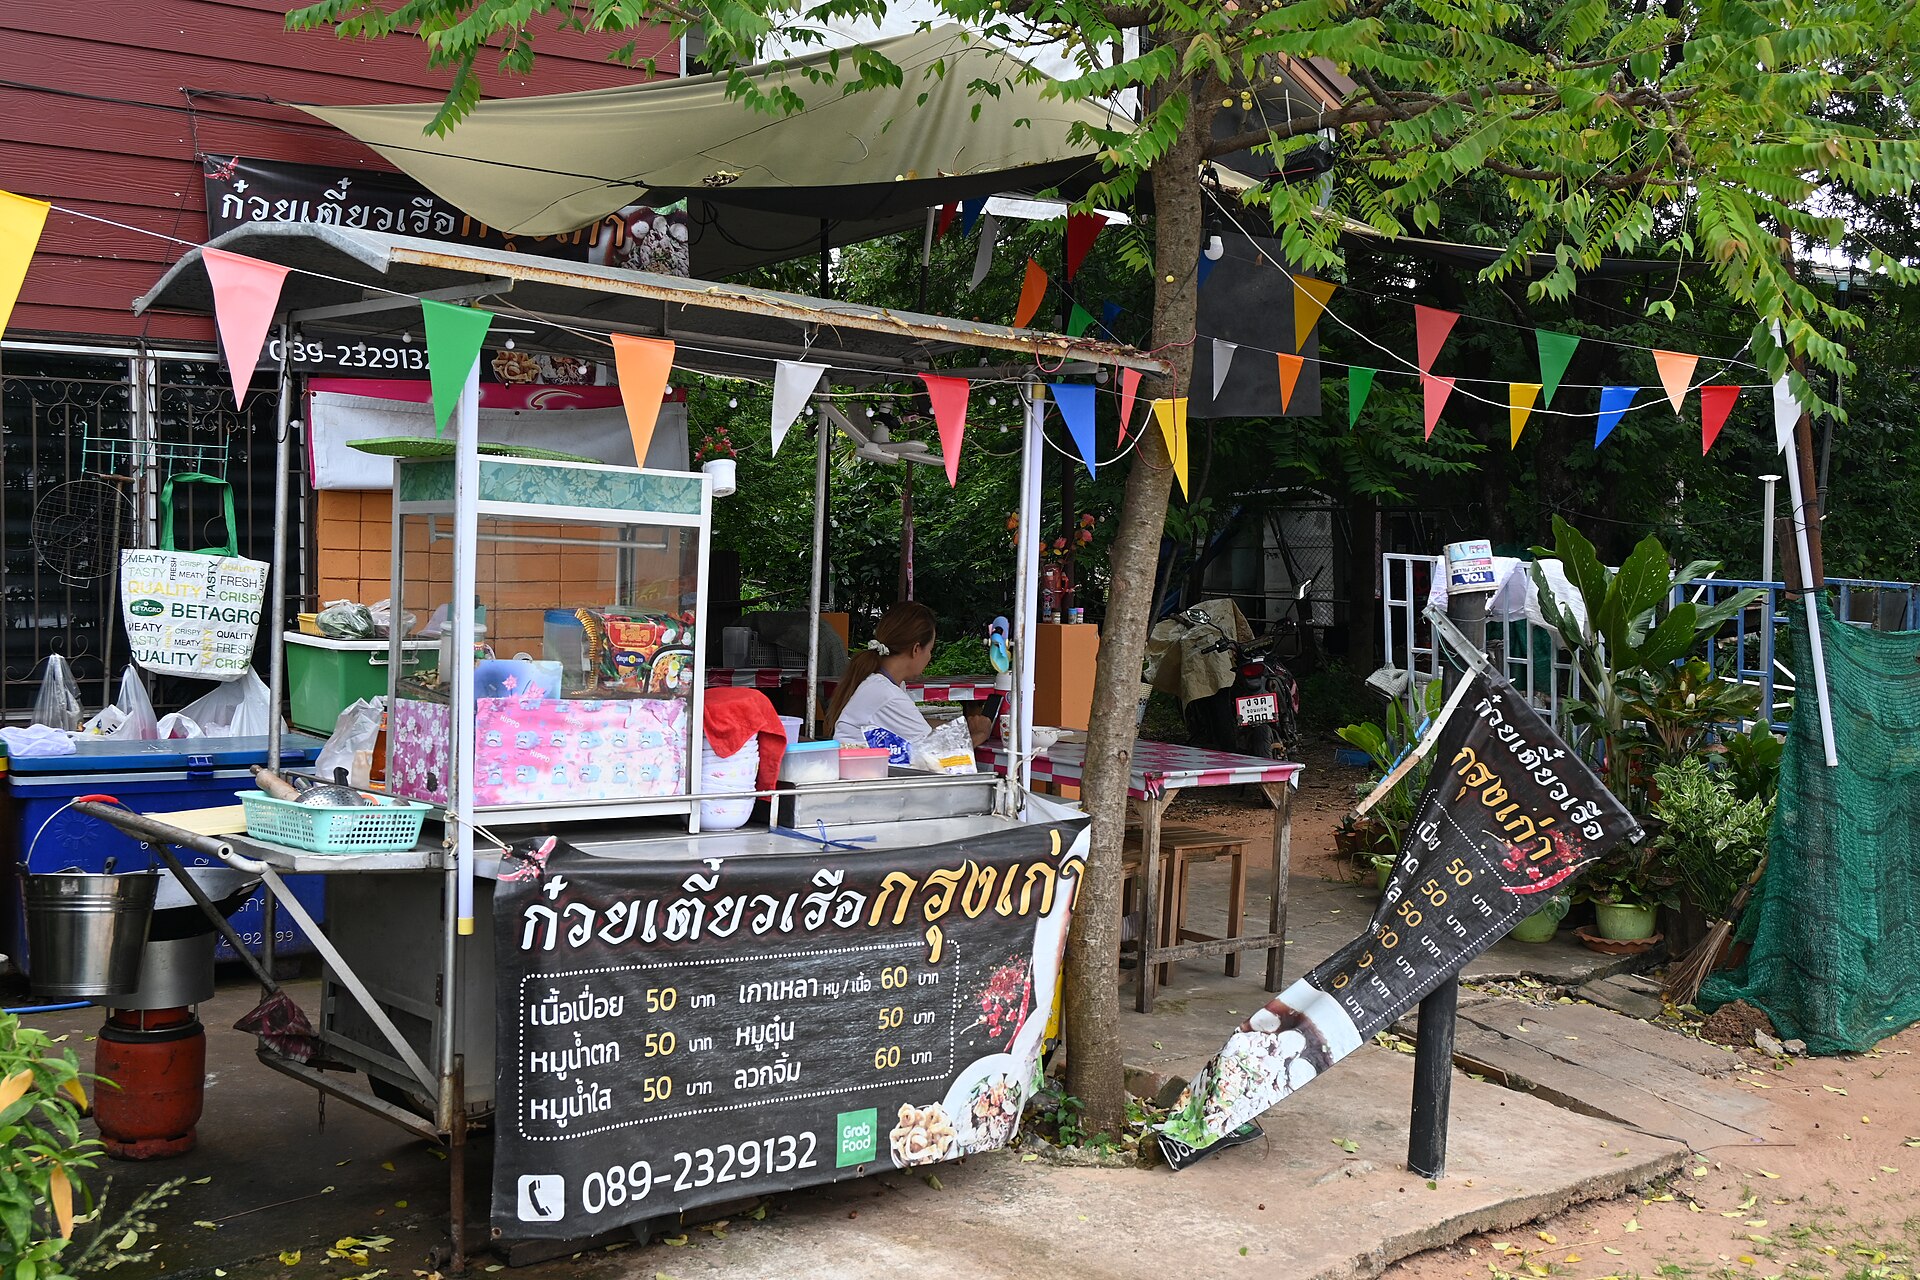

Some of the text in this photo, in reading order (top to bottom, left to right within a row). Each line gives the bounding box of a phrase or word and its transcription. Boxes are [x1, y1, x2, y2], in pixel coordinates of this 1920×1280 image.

[128, 555, 167, 564] MEATY
[180, 560, 205, 568] CRISPY
[220, 563, 256, 572] QUALITY
[128, 567, 166, 578] TASTY
[206, 560, 218, 599] TASTY
[220, 576, 258, 588] FRESH
[1461, 572, 1486, 582] TOA
[128, 580, 202, 598] QUALITY
[132, 605, 162, 613] BETAGRO
[172, 602, 260, 626] BETAGRO
[175, 628, 200, 636] CRISPY
[216, 630, 254, 640] QUALITY
[216, 643, 252, 655] FRESH
[500, 714, 520, 728] HIPPO
[1247, 713, 1268, 722] 300
[530, 750, 551, 763] HIPPO
[1451, 747, 1556, 861] กรุงเก่า
[1445, 857, 1473, 886] 50
[1471, 894, 1493, 917] บาท
[1420, 878, 1468, 938] 50 บาท
[1396, 900, 1423, 928] 50
[1421, 935, 1443, 958] บาท
[1396, 955, 1416, 978] บาท
[739, 977, 818, 1004] เกาเหลา
[881, 966, 908, 990] 60
[918, 972, 939, 986] บาท
[1371, 975, 1391, 999] บาท
[530, 984, 716, 1026] เนื้อเปื่อย 50 บาท
[1345, 995, 1365, 1019] บาท
[878, 1006, 904, 1030] 50
[914, 1010, 936, 1026] บาท
[530, 1031, 713, 1081] หมูน้ำตก 50 บาท
[734, 1046, 933, 1090] ลวกจิ้ม 60 บาท
[530, 1076, 713, 1128] หมูน้ำใส 50 บาท
[842, 1122, 870, 1140] Grab
[842, 1135, 871, 1153] Food
[582, 1130, 818, 1214] 089-2329132
